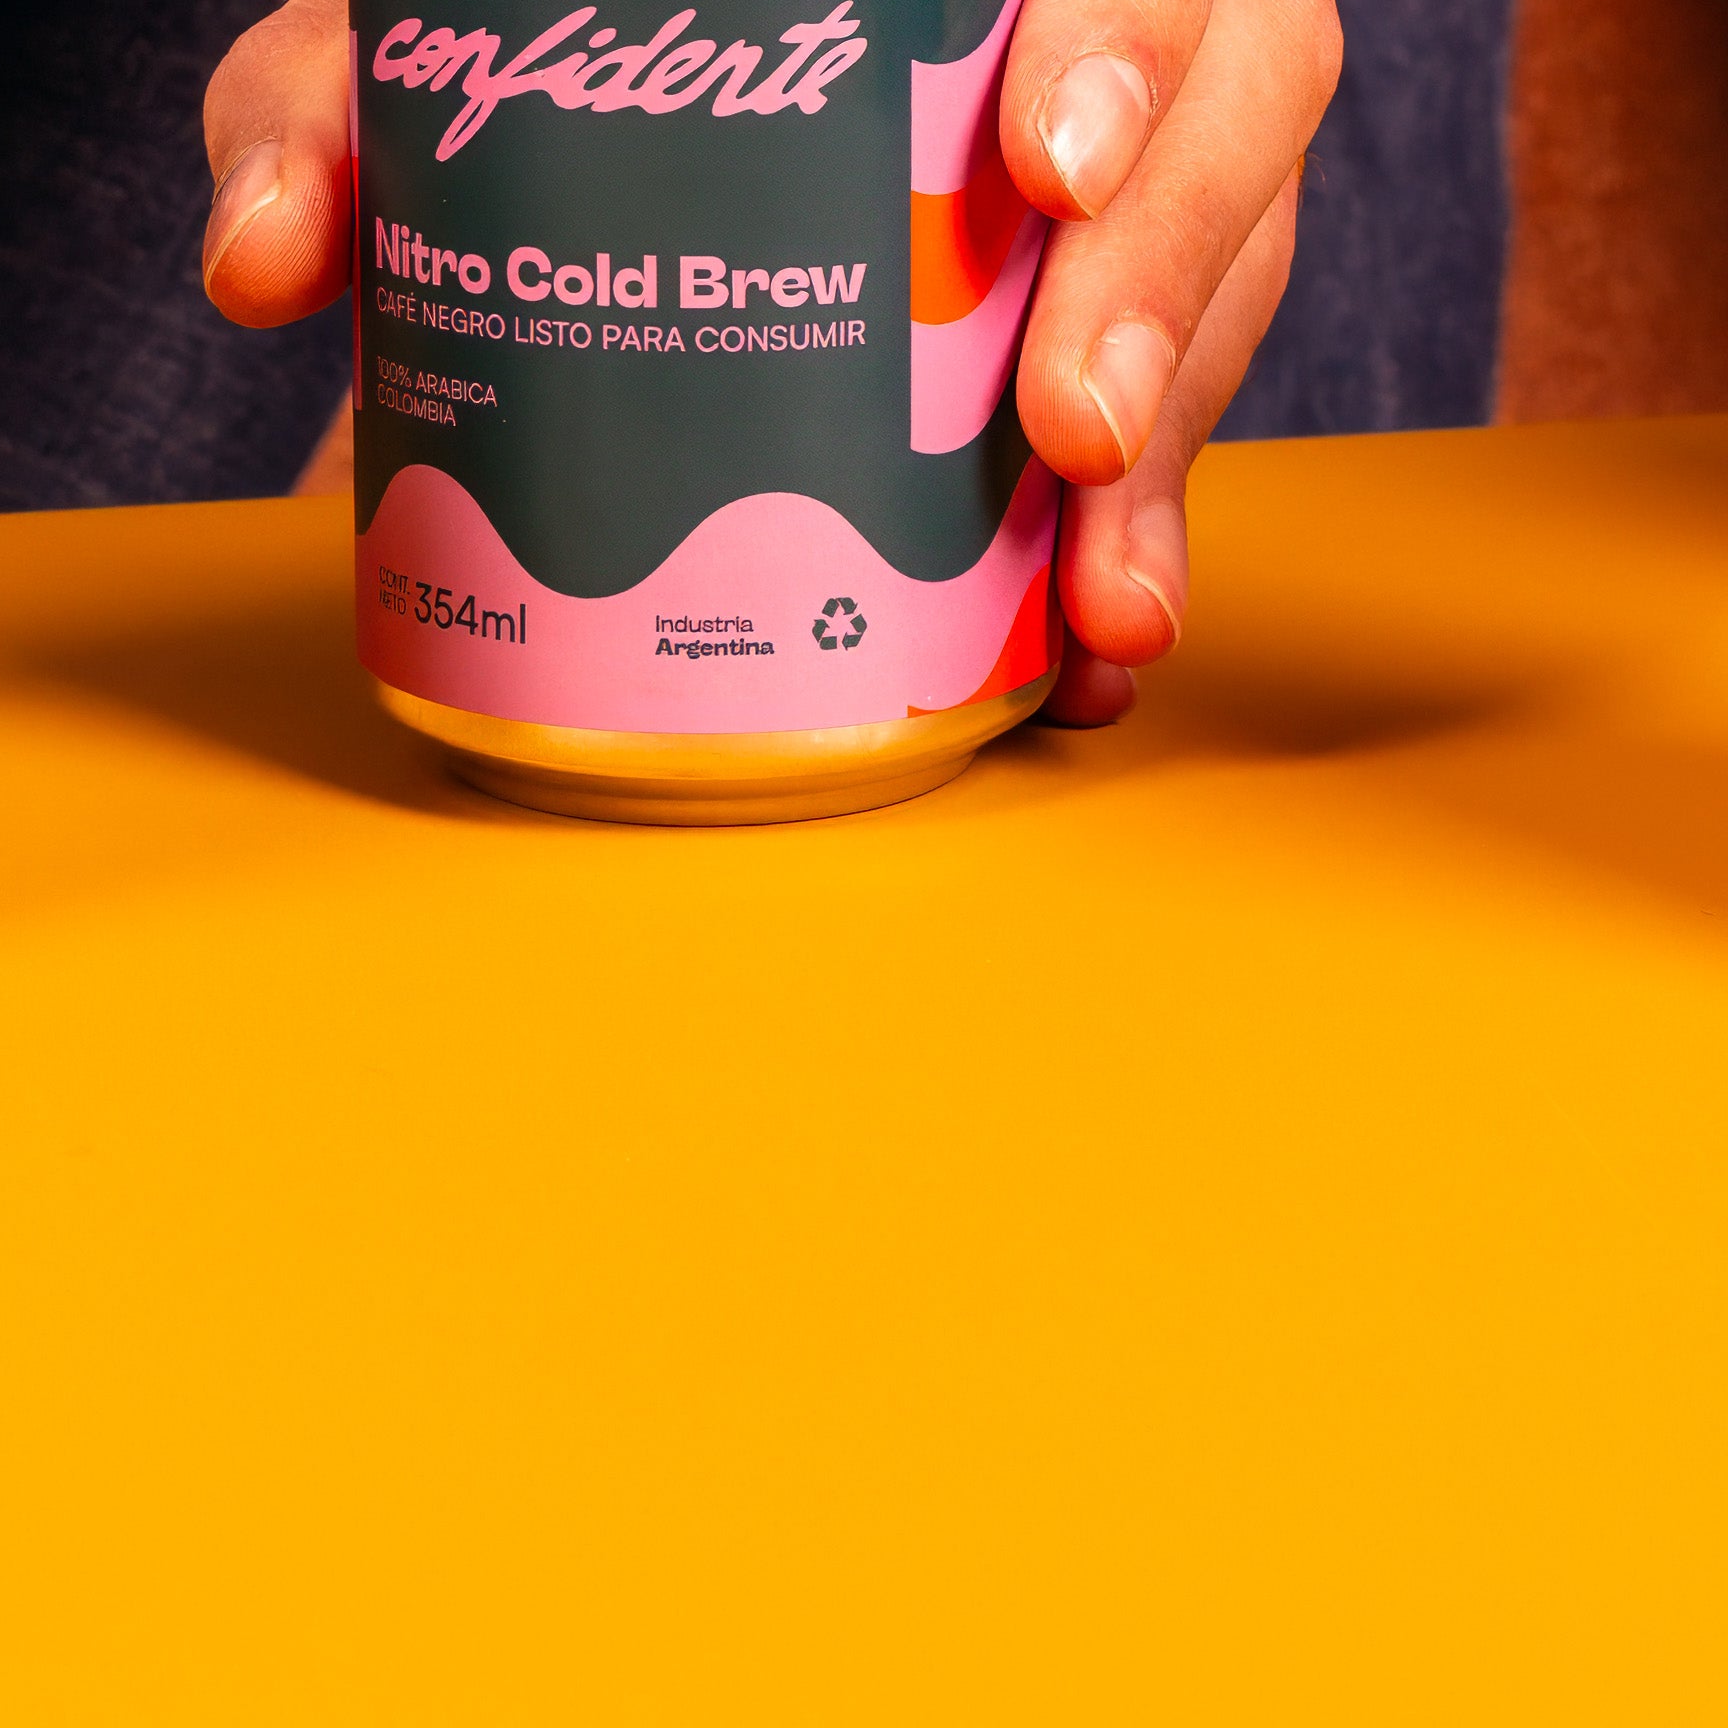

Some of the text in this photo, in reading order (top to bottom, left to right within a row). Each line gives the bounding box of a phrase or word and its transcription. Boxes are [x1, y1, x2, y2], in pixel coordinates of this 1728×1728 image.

[373, 0, 867, 162] confidente
[375, 217, 867, 309] Nitro Cold Brew
[376, 286, 866, 353] CAFÉ NEGRO LISTO PARA CONSUMIR
[377, 356, 498, 408] 100% ARABICA
[377, 383, 457, 427] COLOMBIA
[414, 581, 527, 645] 354ml
[655, 615, 754, 633] Industria
[655, 637, 775, 660] Argentina
